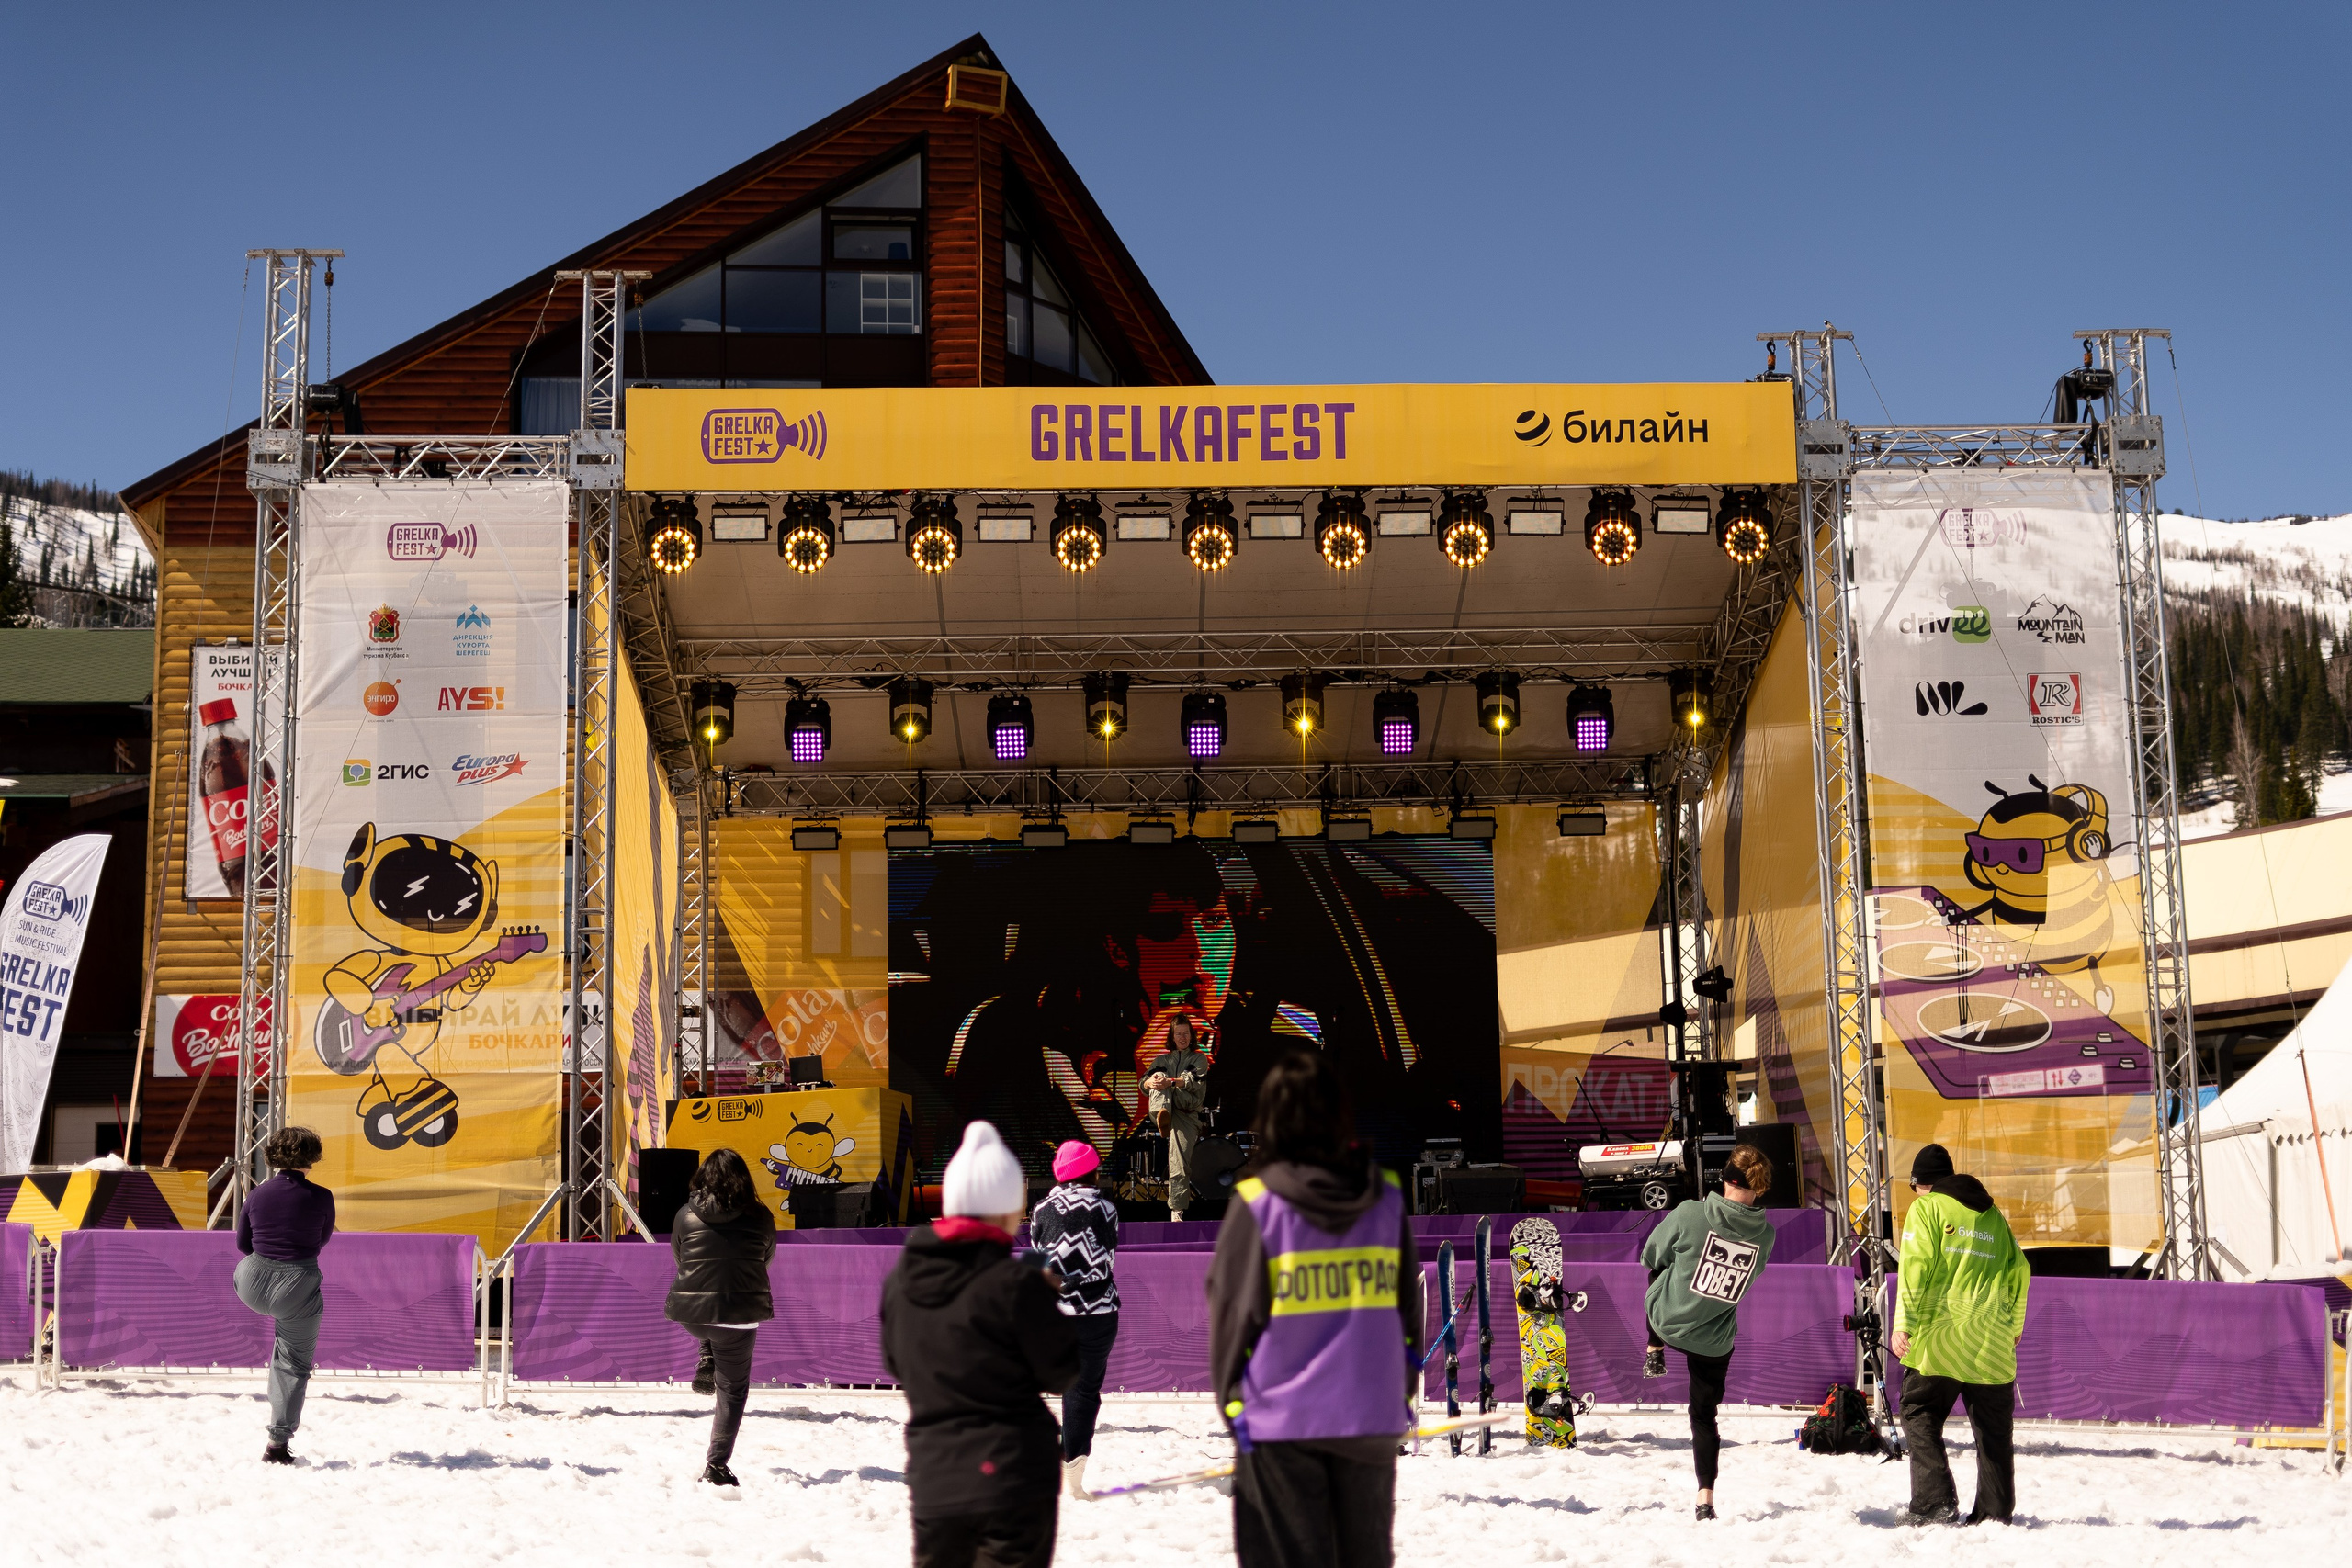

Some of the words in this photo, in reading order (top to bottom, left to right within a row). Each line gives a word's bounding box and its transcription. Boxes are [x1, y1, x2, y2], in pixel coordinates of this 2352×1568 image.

[714, 416, 774, 434] GRELKA
[1030, 402, 1355, 462] GRELKAFEST
[1563, 409, 1709, 444] билайн
[714, 437, 753, 456] FEST
[1948, 513, 1990, 527] GRELKA
[396, 527, 438, 540] GRELKA
[1949, 528, 1975, 542] FEST
[396, 542, 424, 556] FEST
[1898, 610, 1992, 637] drivee
[2018, 618, 2084, 632] MOUNTAIN
[2055, 632, 2086, 644] MAN
[209, 653, 277, 664] ВЫБИЙ
[368, 694, 396, 705] энгиро
[437, 687, 505, 711] AYS!
[2032, 716, 2081, 724] ROSTIC'S
[378, 764, 430, 780] 2ГИС
[209, 793, 278, 826] Coa
[30, 886, 62, 904] GRELKA
[28, 898, 48, 913] FEST
[18, 919, 33, 932] SUN
[33, 925, 39, 933] &
[40, 925, 56, 938] RIDE
[469, 1033, 571, 1049] БОЧКАРИ
[1507, 1062, 1653, 1122] ПРОКАТ
[721, 1102, 744, 1111] GRELKA
[721, 1111, 737, 1119] FEST
[1958, 1226, 1995, 1244] билайн
[1696, 1261, 1747, 1299] OBEY
